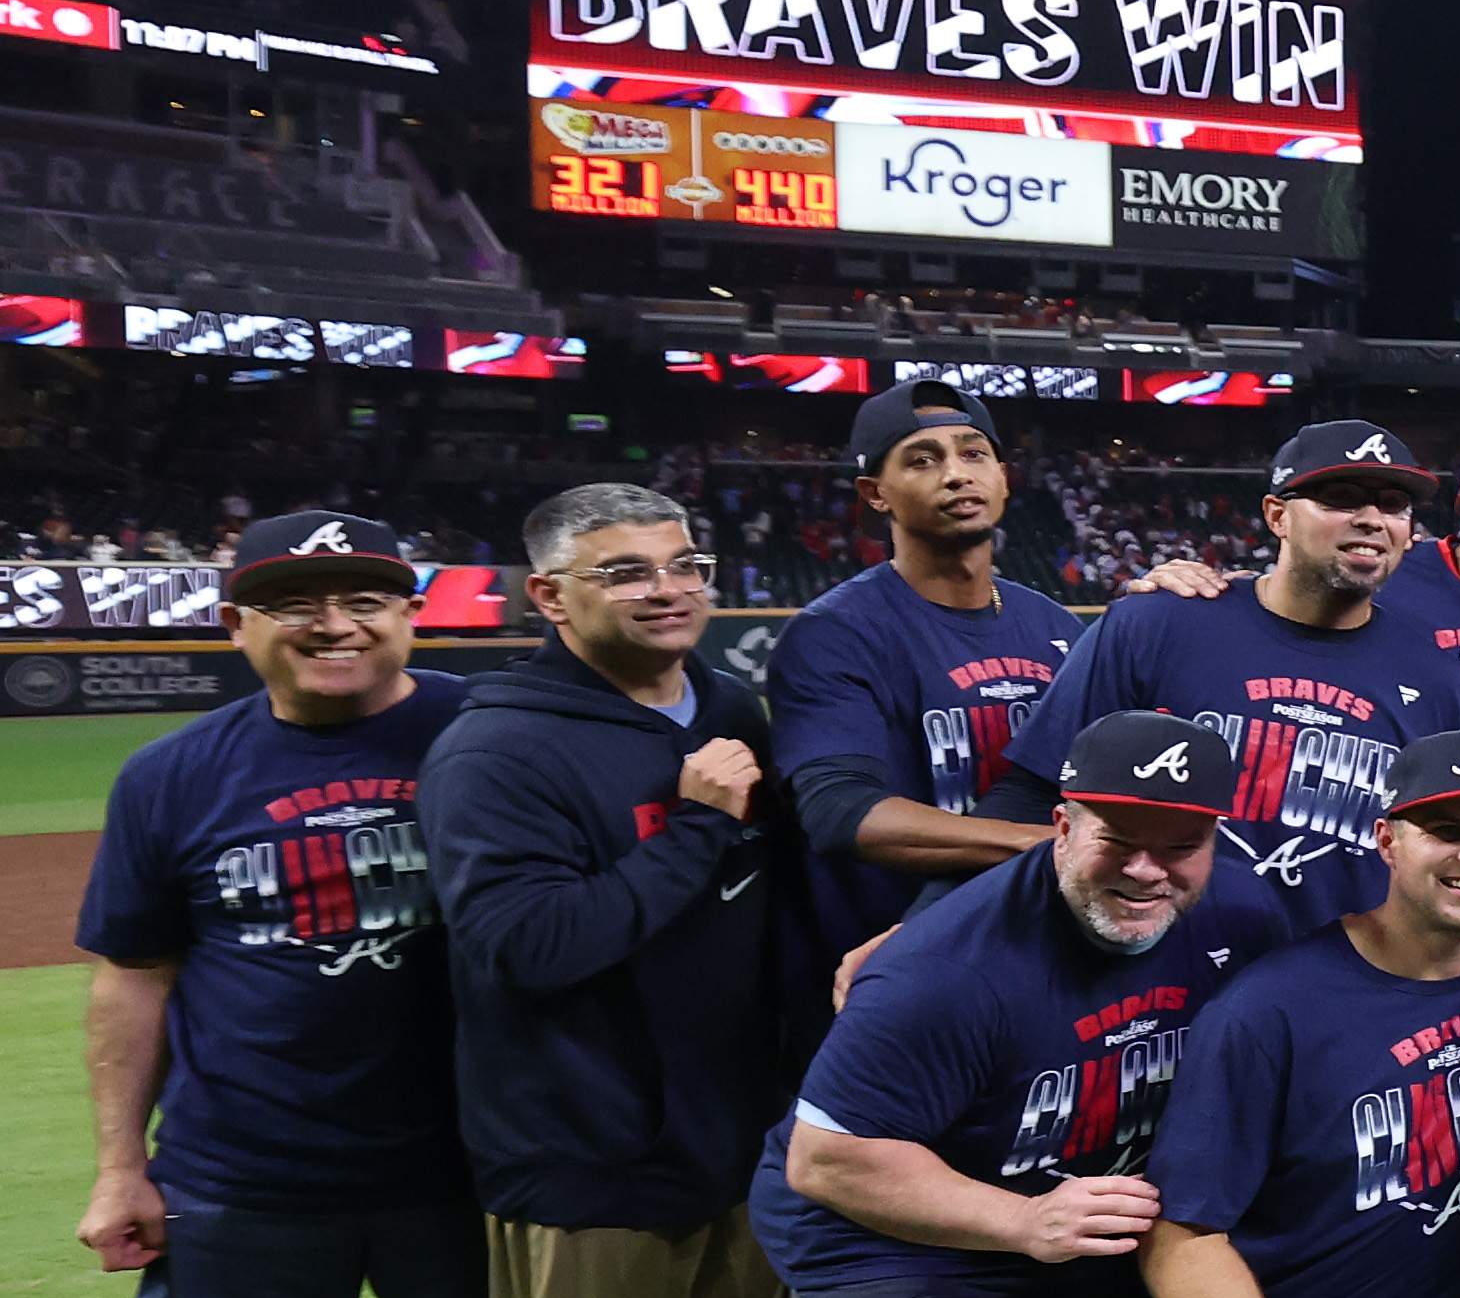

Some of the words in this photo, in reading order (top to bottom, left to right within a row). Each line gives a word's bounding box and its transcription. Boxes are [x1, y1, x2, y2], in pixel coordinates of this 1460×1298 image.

[550, 155, 660, 200] 321
[734, 168, 836, 213] 440
[883, 138, 1067, 228] Kroger
[1119, 167, 1290, 214] EMORY
[735, 204, 837, 230] MILLION
[1122, 206, 1282, 232] HEALTHCARE
[124, 304, 316, 362] BRAVES
[77, 566, 221, 629] WIN
[80, 656, 191, 675] SOUTH
[80, 675, 222, 696] COLLEGE
[948, 656, 1053, 690] BRAVES
[1244, 677, 1376, 721] BRAVES
[1271, 702, 1343, 725] POSTSEASON
[1074, 986, 1189, 1042] BRAVES
